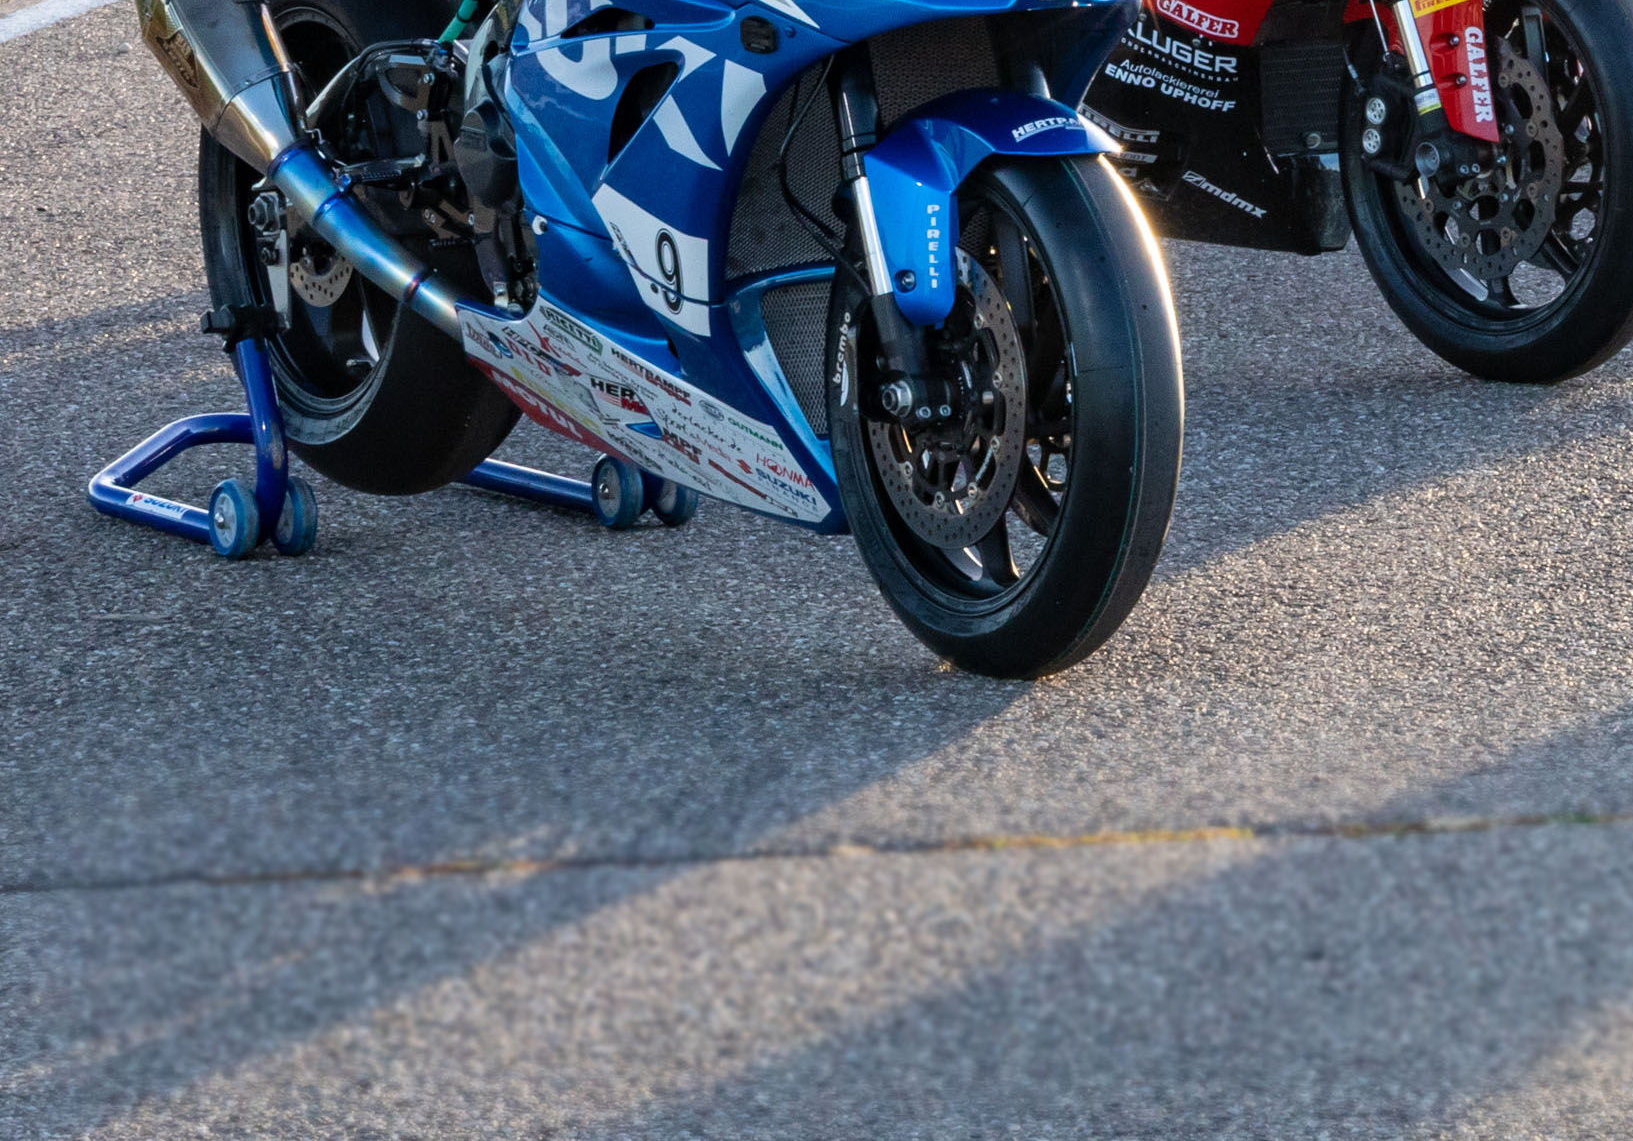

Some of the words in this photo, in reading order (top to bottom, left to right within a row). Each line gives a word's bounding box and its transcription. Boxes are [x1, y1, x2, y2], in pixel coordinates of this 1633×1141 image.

[1119, 58, 1221, 99] Autolackiererei
[1127, 21, 1238, 74] LUGER
[1464, 26, 1494, 123] GALFER
[1104, 62, 1156, 89] ENNO
[1159, 82, 1237, 113] UPHOFF
[655, 227, 685, 314] 9
[926, 204, 941, 289] PIRELLI
[832, 311, 851, 385] brembo
[754, 467, 817, 507] SUZUKI
